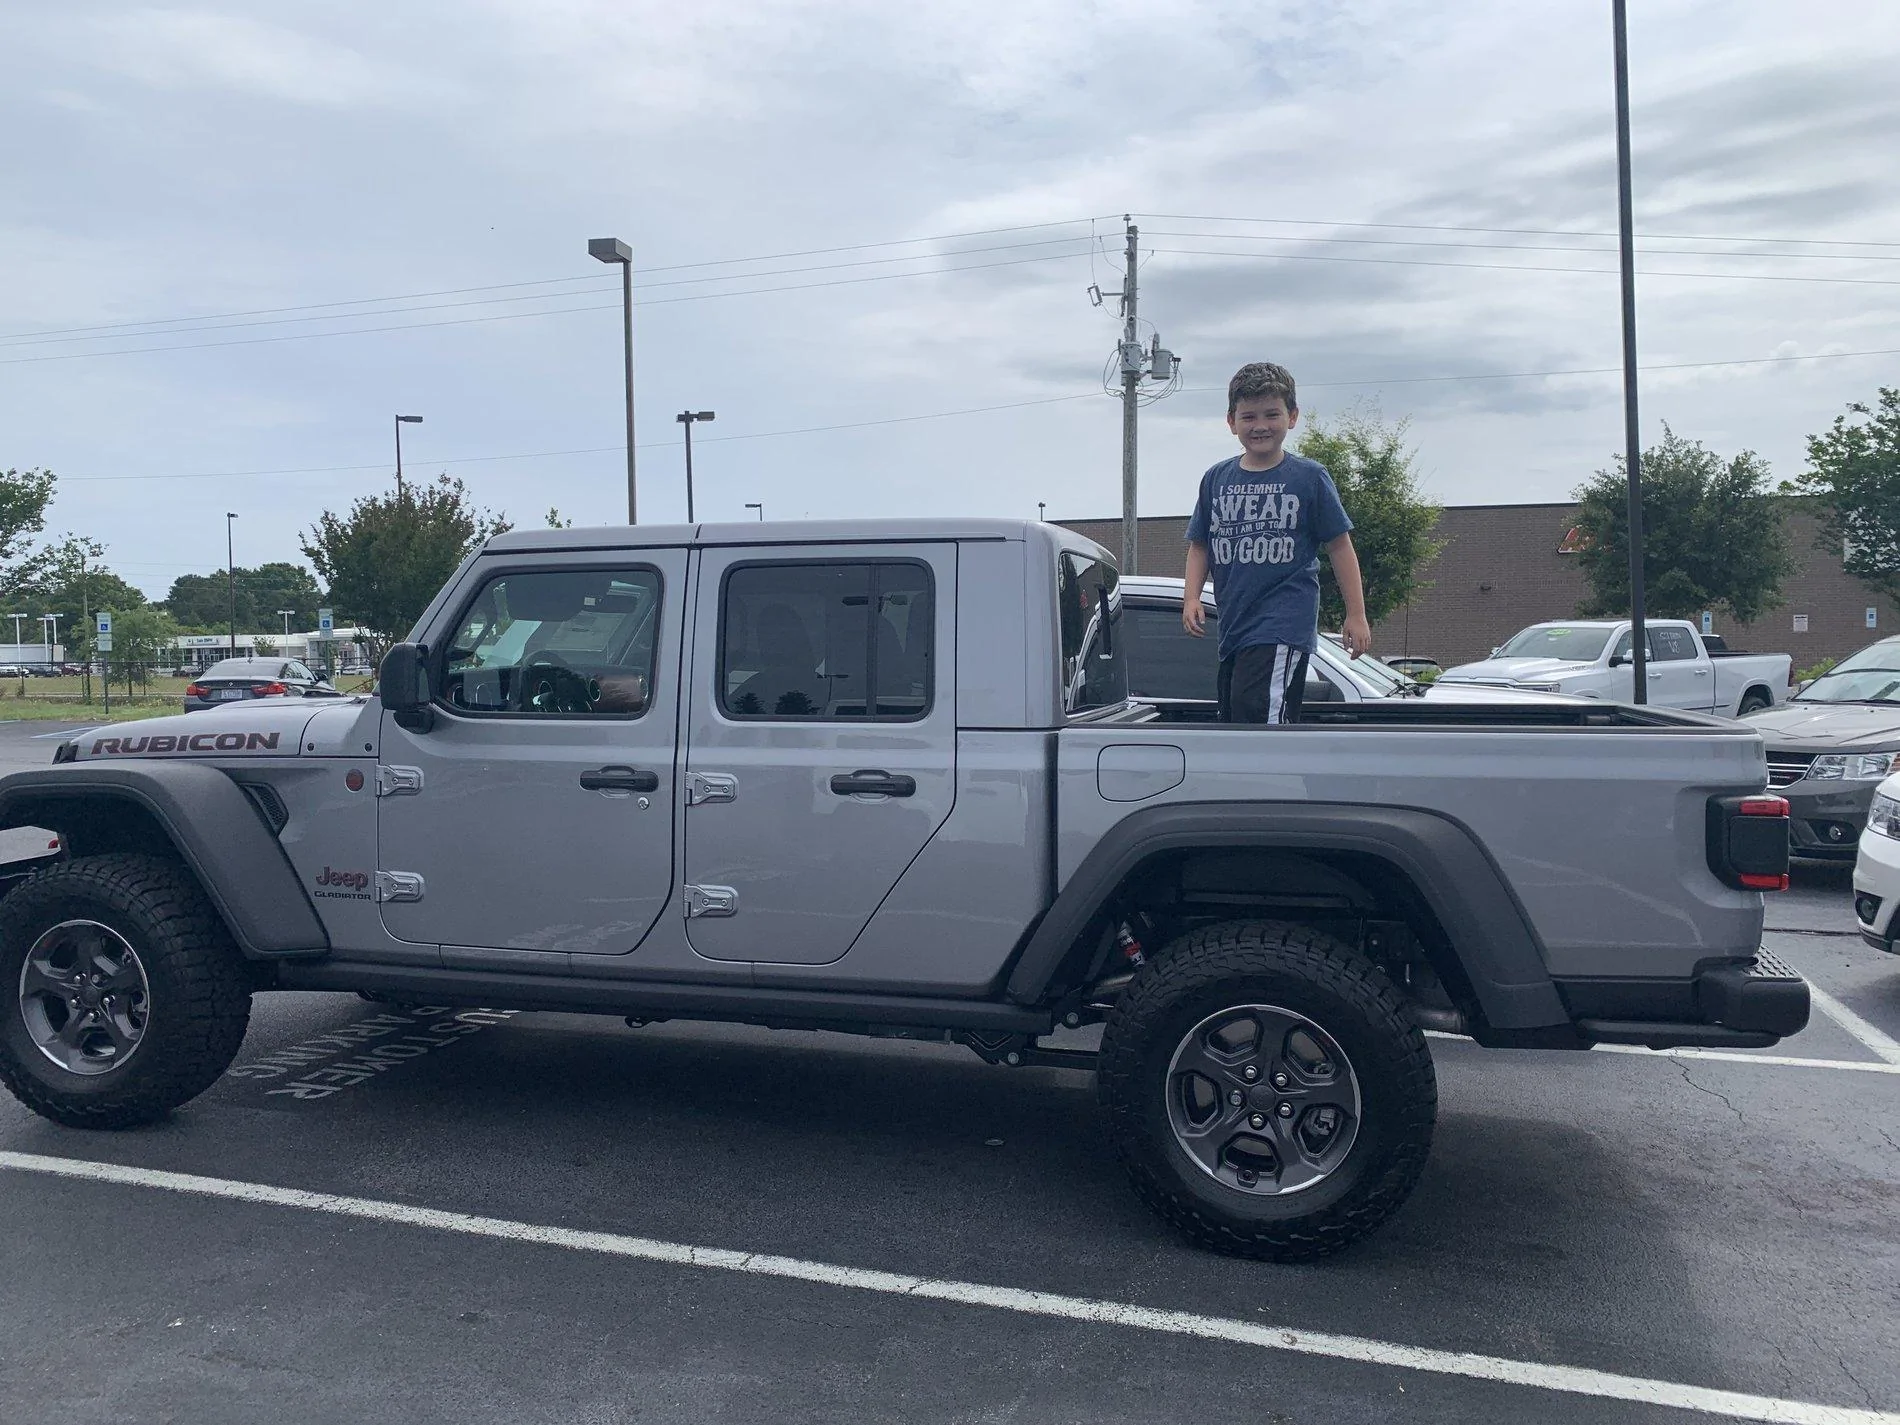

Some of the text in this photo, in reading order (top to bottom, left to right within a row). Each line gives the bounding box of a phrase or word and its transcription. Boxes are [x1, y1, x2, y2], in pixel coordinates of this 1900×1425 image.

[1219, 483, 1287, 496] I SOLEMNLY
[1240, 523, 1253, 533] AM
[1255, 521, 1266, 531] UP
[1268, 520, 1279, 529] TO
[1238, 536, 1295, 565] GOOD
[91, 732, 281, 755] RUBICON
[316, 866, 369, 892] Jeep
[314, 890, 372, 900] GLADIATOR
[264, 1007, 521, 1100] USTOMER
